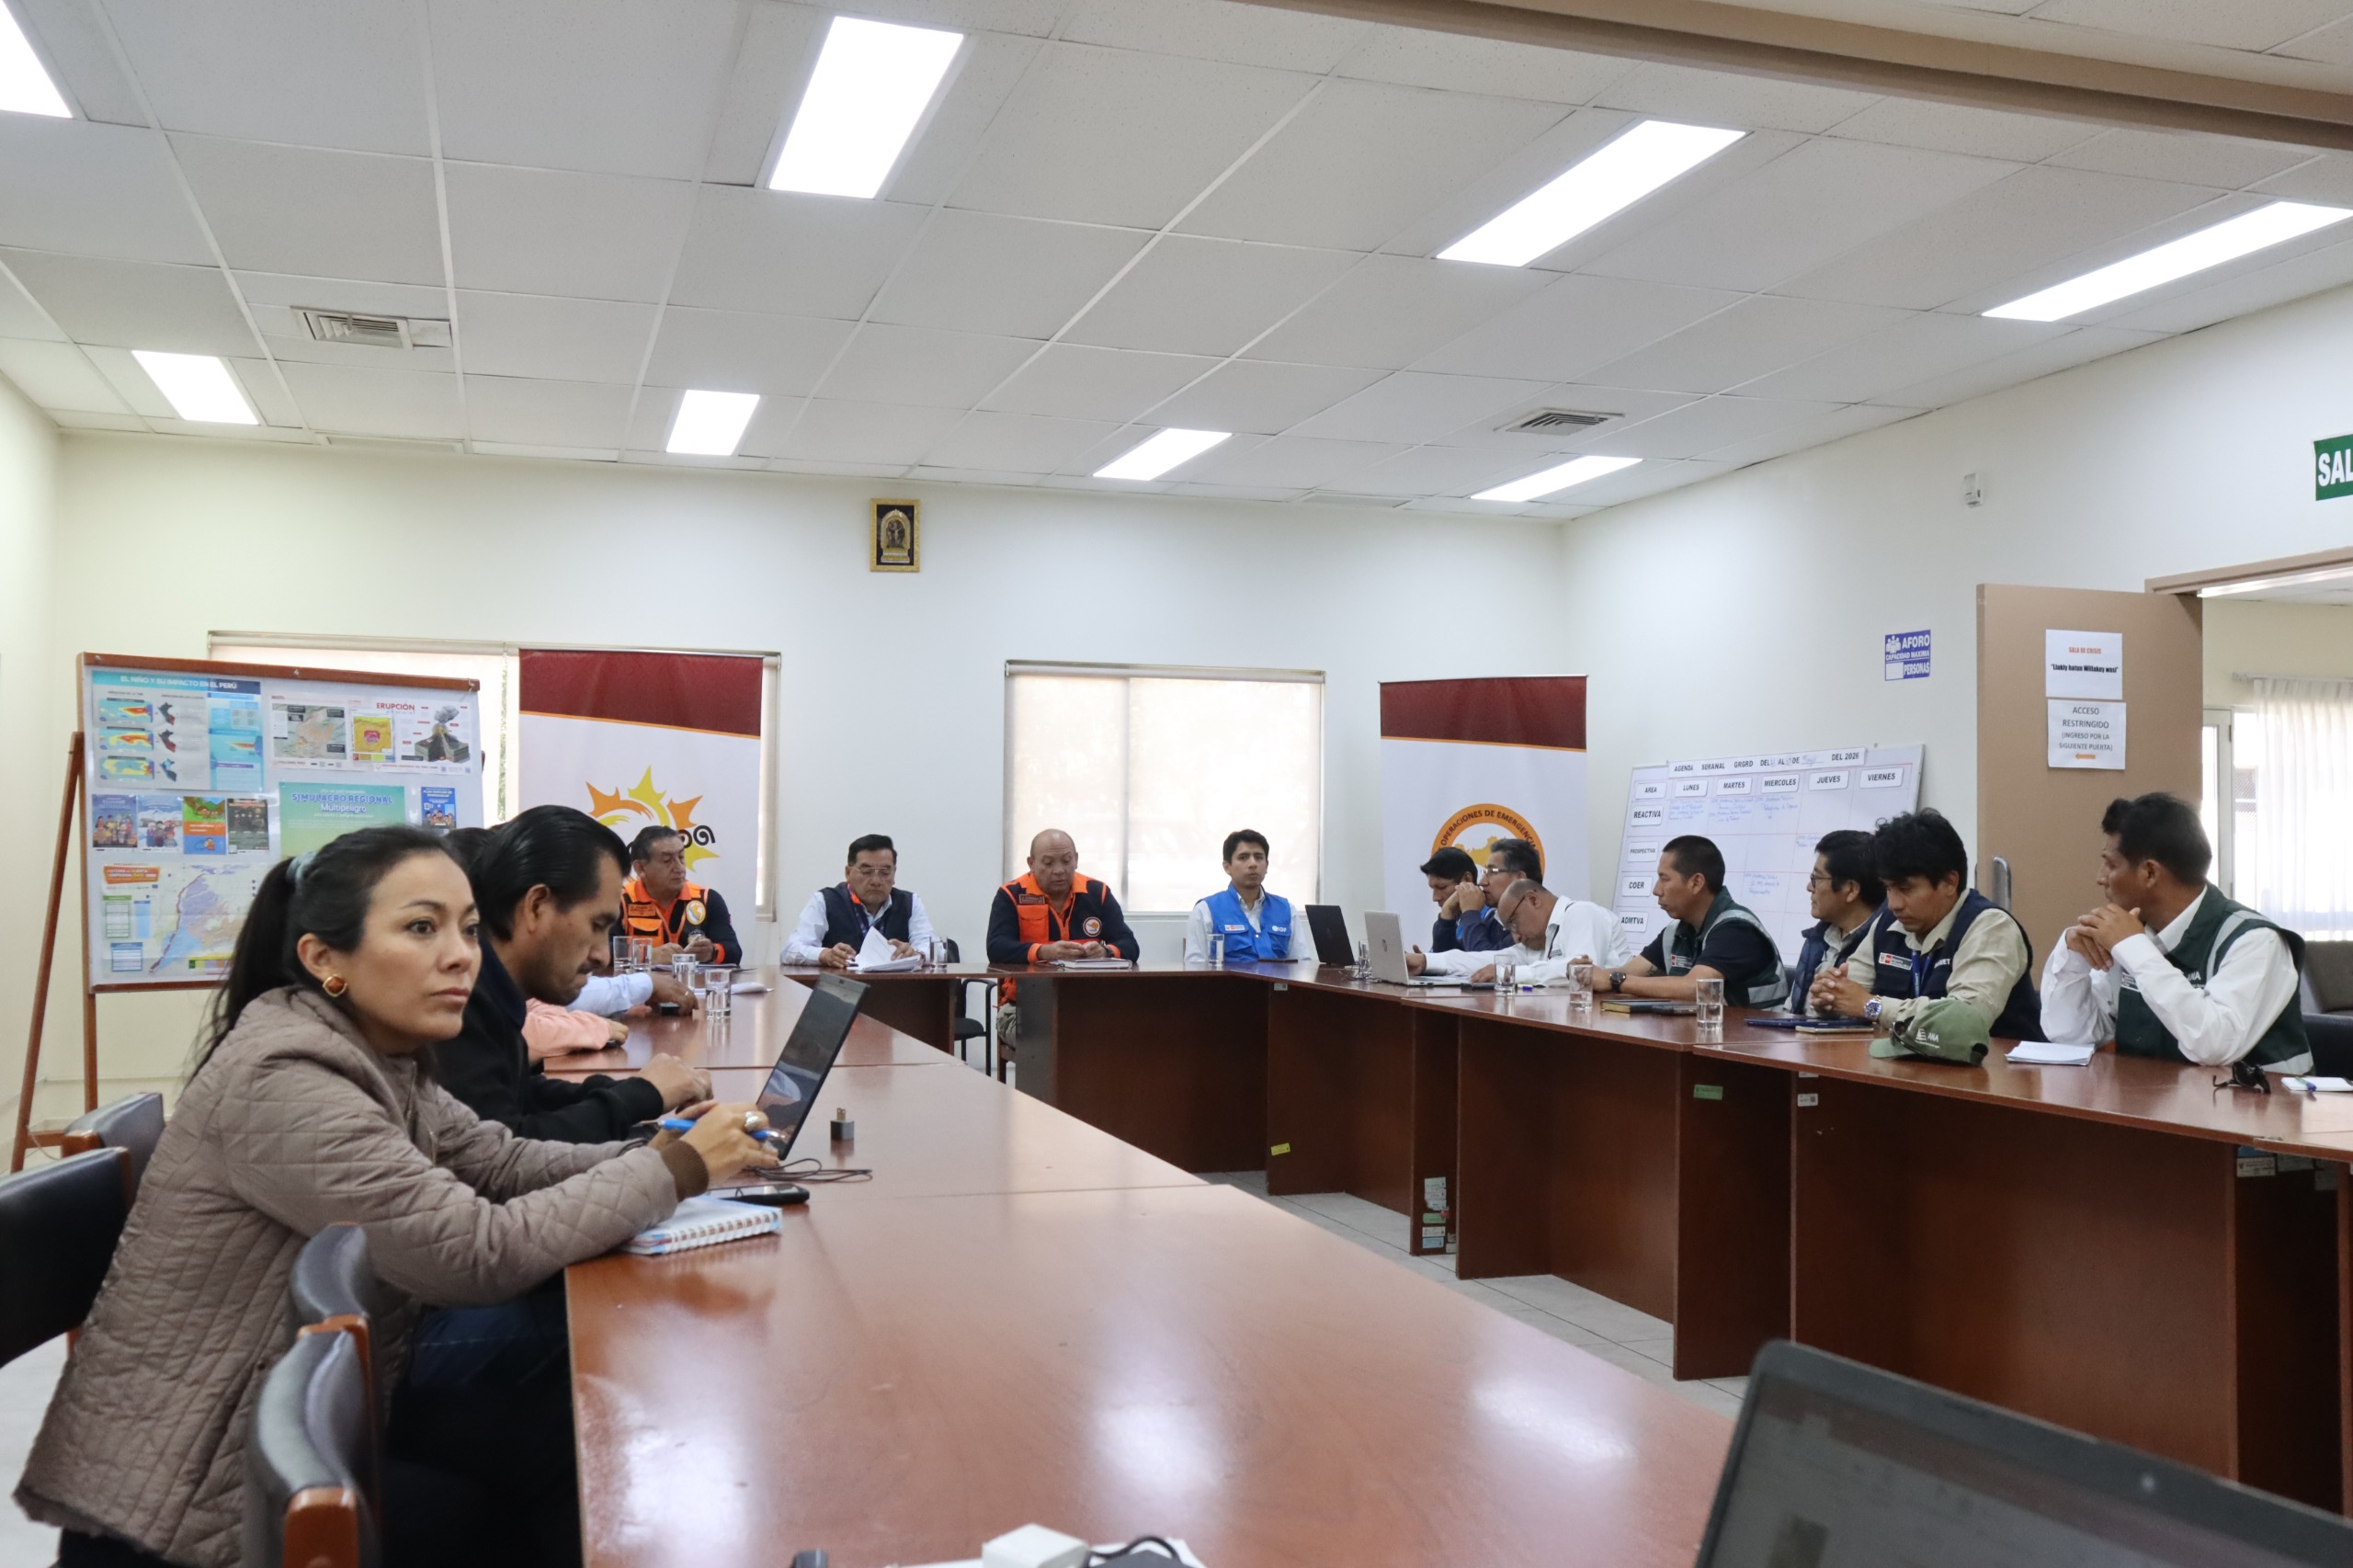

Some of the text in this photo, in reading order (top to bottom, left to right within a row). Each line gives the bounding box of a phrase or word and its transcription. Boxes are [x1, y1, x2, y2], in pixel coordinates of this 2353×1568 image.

[2318, 449, 2353, 486] SAL
[1902, 634, 1930, 649] AFORO
[1886, 650, 1929, 660] CAPACIDAD MAXIMA
[1904, 662, 1930, 676] PERSONAS
[2073, 707, 2099, 715] ACCESO
[2063, 720, 2109, 728] RESTRINGIDO
[1831, 753, 1843, 761] DEL
[1764, 778, 1796, 787] MIERCOLES
[1817, 775, 1841, 784] JUEVES
[1867, 773, 1896, 781] VIERNES
[292, 794, 393, 803] SIMULACRO REGIONAL
[1634, 810, 1661, 818] REACTIVA
[1441, 810, 1483, 846] OPERACIONES
